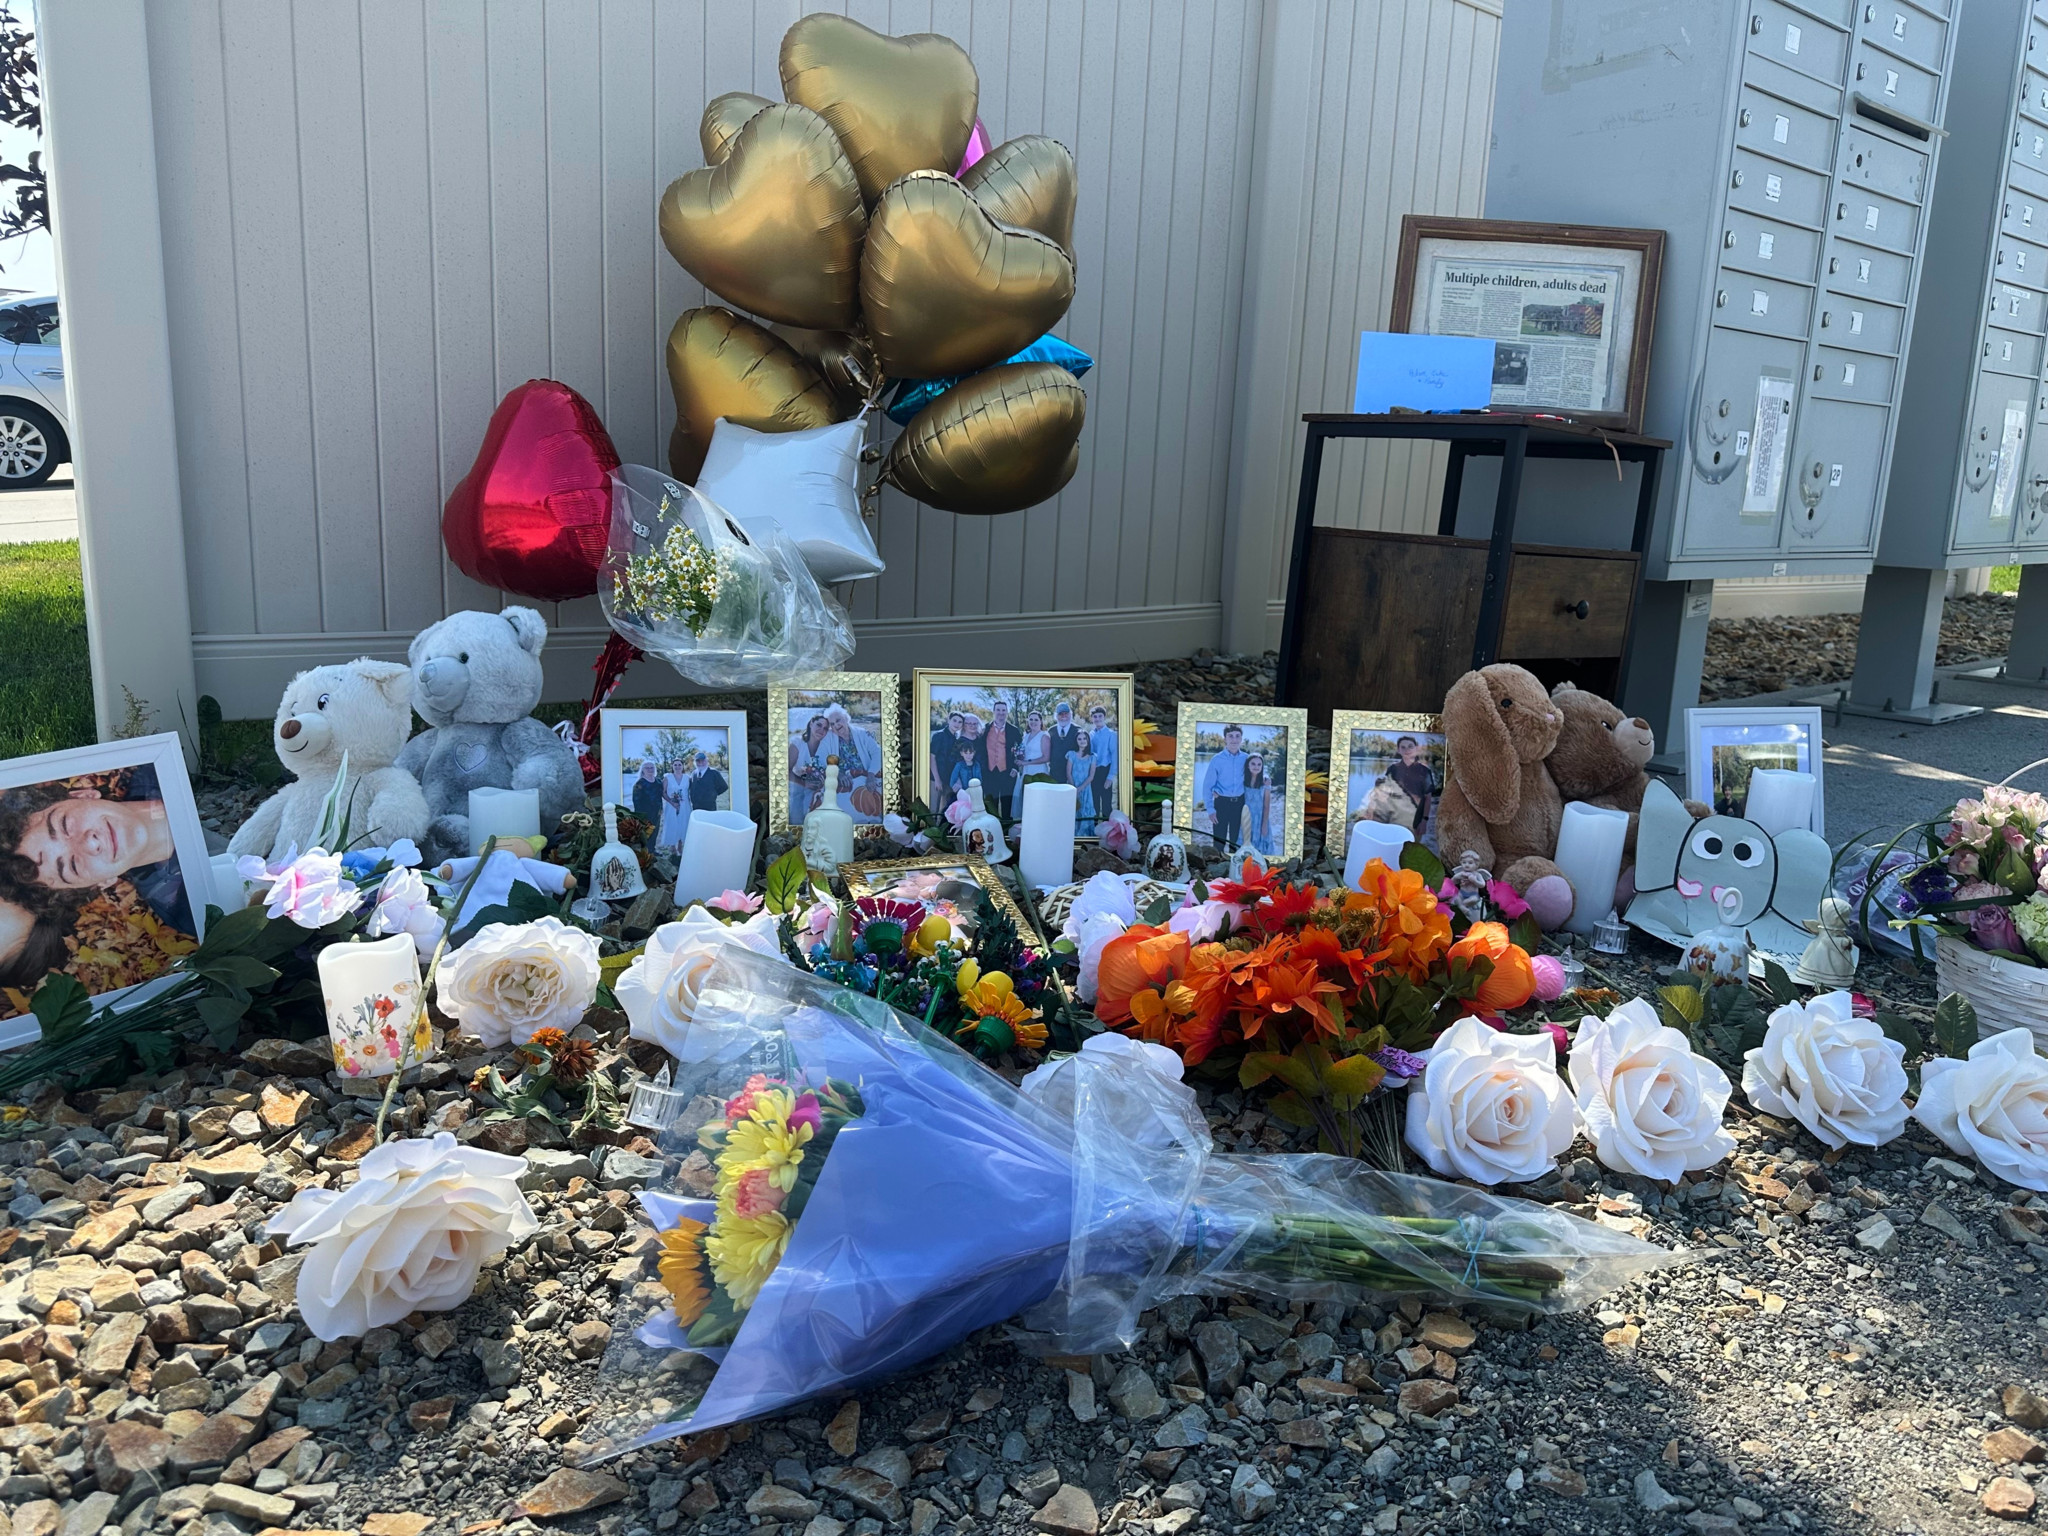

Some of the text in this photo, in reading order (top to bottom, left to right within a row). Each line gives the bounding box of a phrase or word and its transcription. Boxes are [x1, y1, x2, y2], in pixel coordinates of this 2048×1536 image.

[1444, 271, 1606, 294] Multiple children, adults dead
[1738, 436, 1748, 450] 1P
[1832, 468, 1841, 481] 2P
